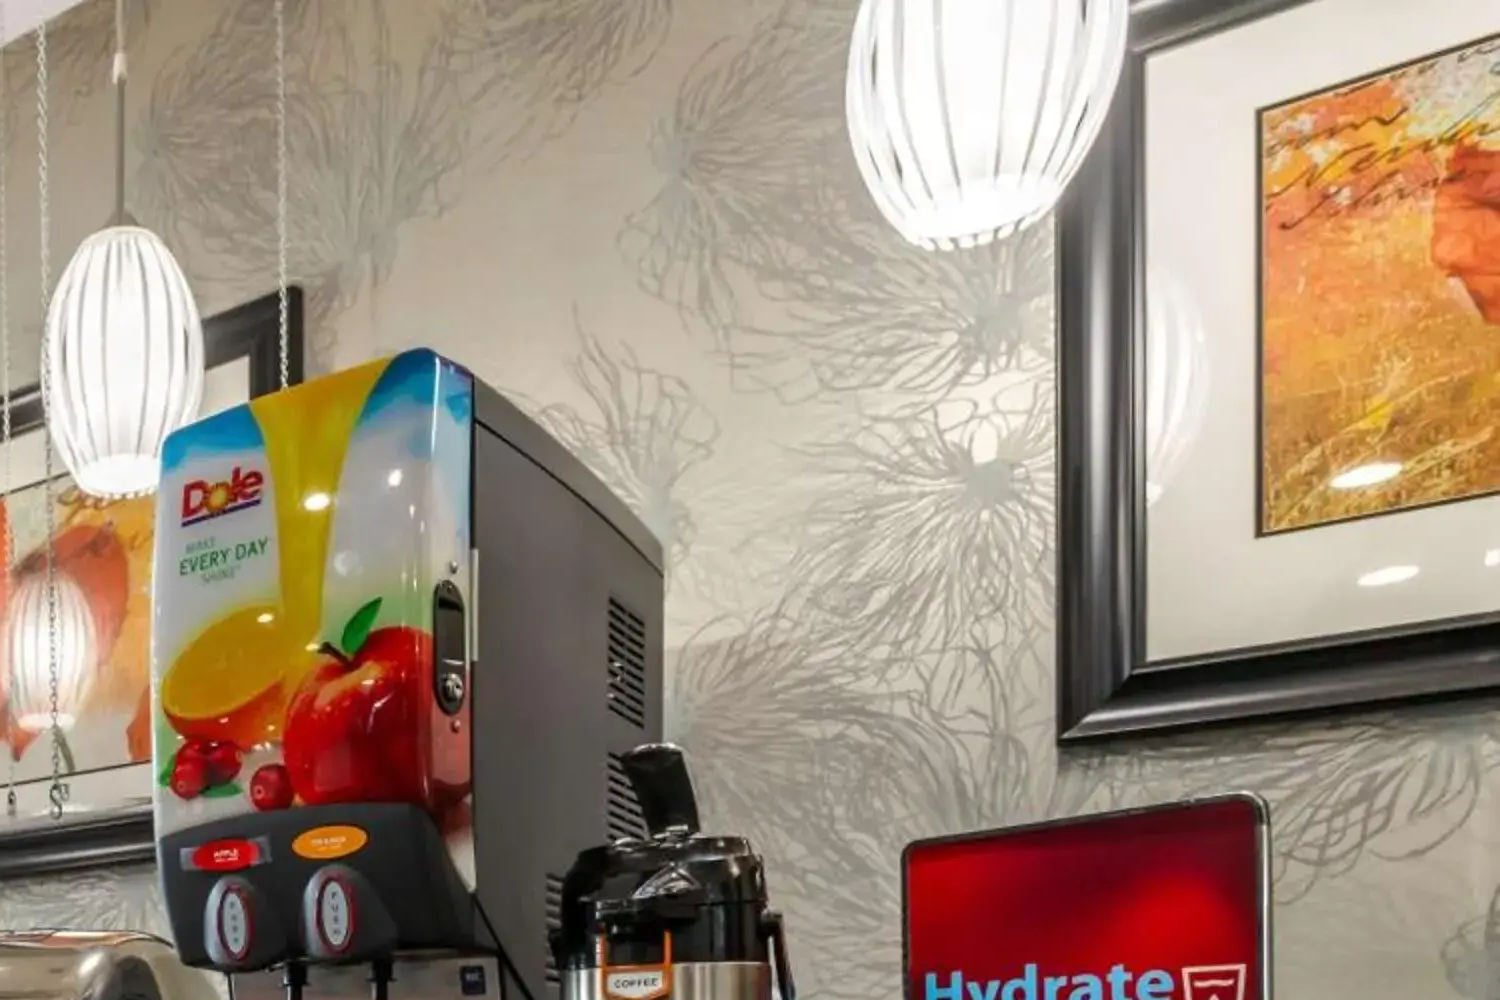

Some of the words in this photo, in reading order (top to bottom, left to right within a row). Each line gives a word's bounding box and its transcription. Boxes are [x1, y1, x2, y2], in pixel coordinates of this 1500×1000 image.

[182, 466, 264, 519] Dole
[179, 549, 231, 577] EVERY
[235, 537, 269, 561] DAY
[612, 977, 660, 989] COFFEE
